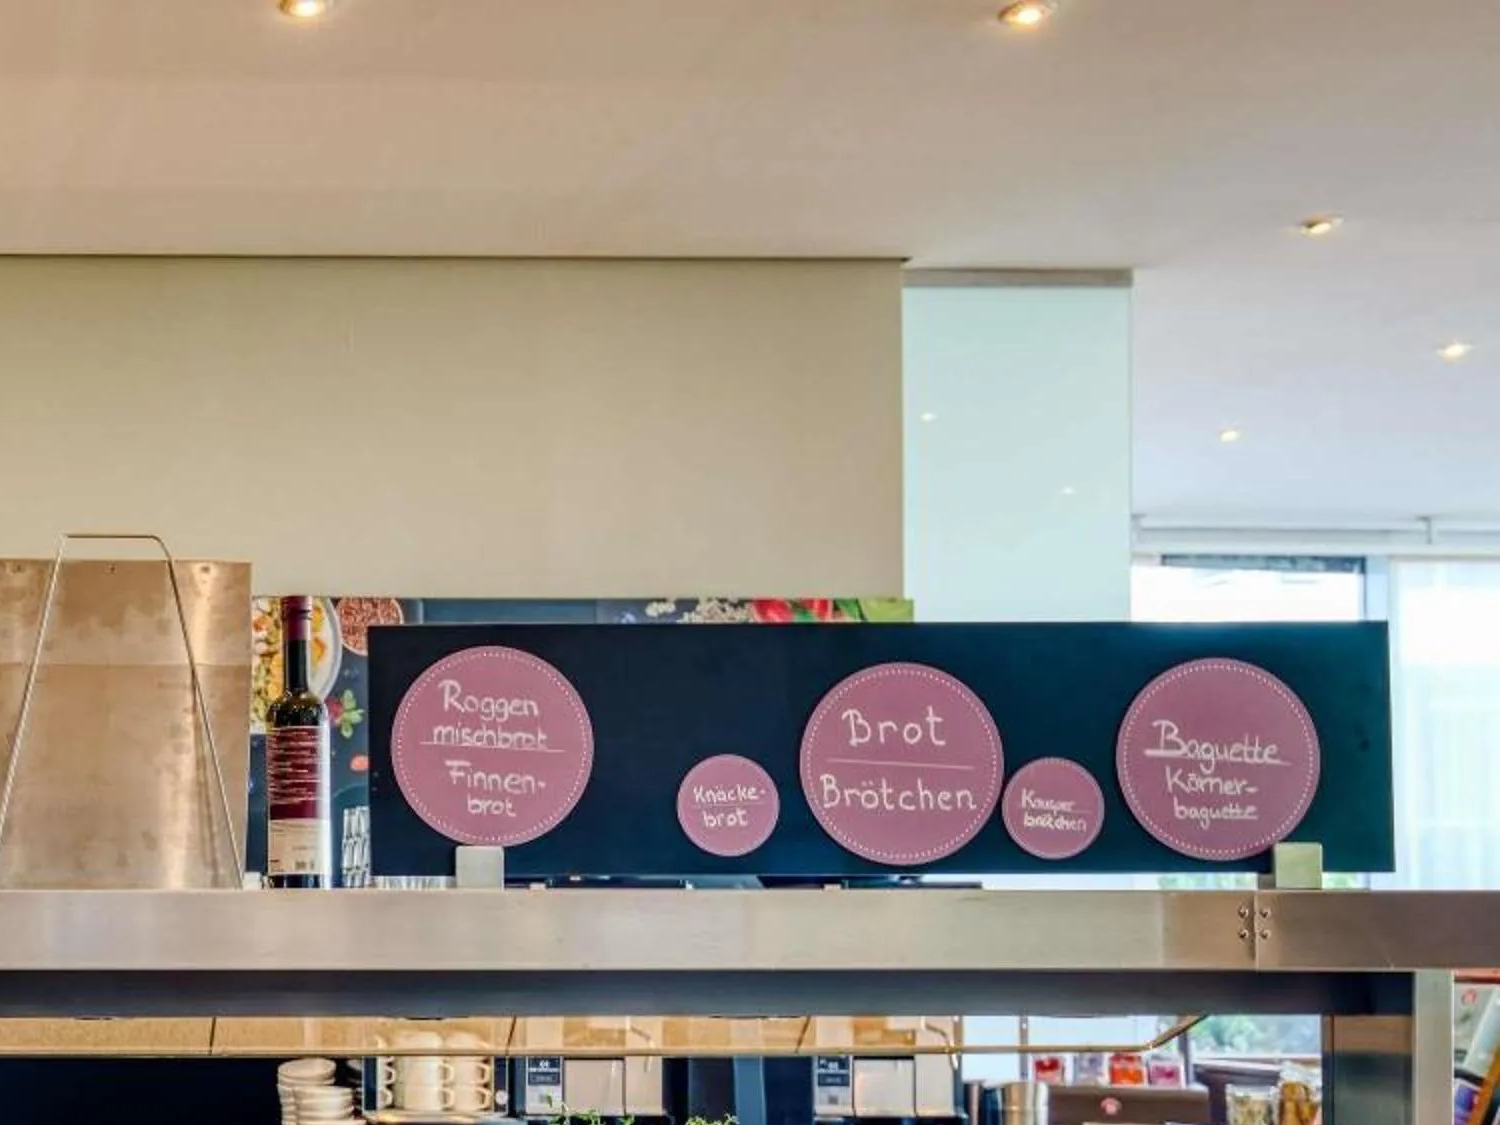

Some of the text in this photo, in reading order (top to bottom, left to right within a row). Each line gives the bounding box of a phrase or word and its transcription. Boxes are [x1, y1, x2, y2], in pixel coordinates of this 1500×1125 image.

[438, 678, 539, 723] Roggen
[433, 721, 548, 750] mischbrot
[841, 705, 947, 747] Brot
[1152, 719, 1283, 774] Baguette
[444, 760, 547, 795] Finnen-
[693, 784, 766, 804] Knäcke-
[820, 773, 978, 812] Brötchen
[1164, 765, 1259, 796] Körner-
[467, 793, 517, 818] brot
[702, 806, 749, 829] brot
[1173, 795, 1259, 830] baguette
